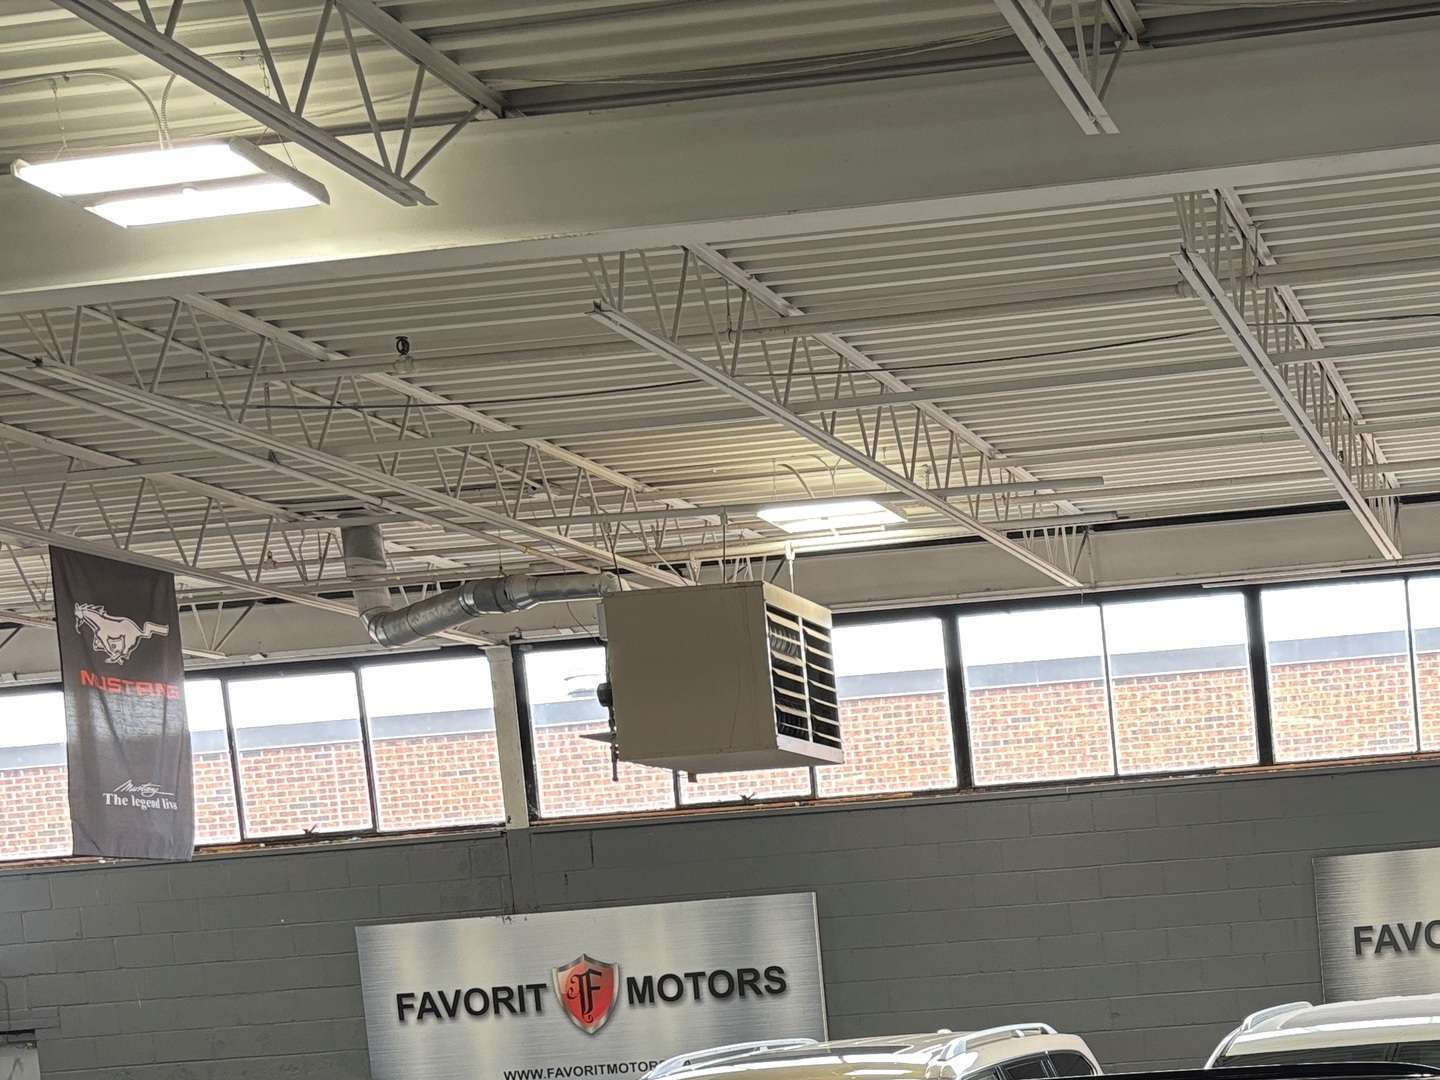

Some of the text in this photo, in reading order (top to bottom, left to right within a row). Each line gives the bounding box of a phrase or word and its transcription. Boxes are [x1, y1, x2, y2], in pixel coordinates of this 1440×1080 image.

[102, 793, 129, 806] The
[131, 795, 160, 810] legend
[396, 983, 548, 1021] FAVORIT
[626, 965, 787, 1005] MOTORS
